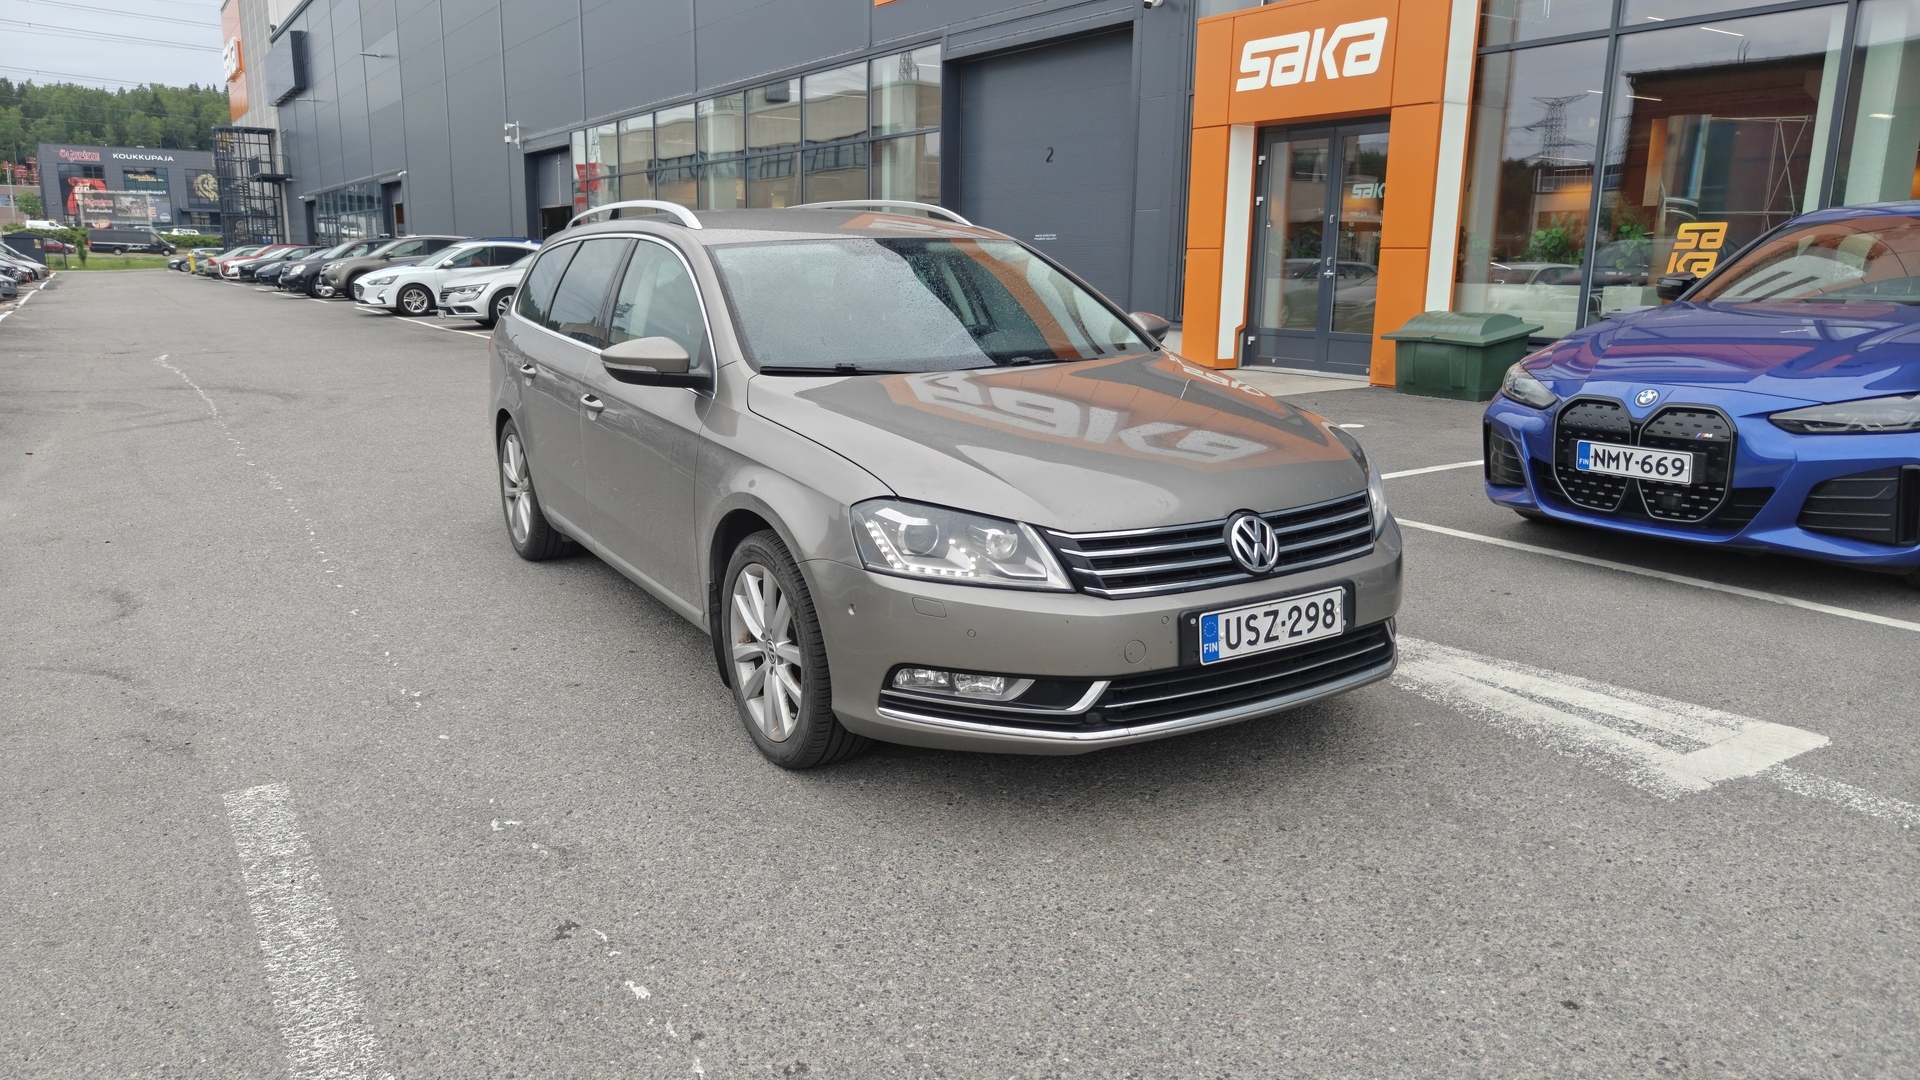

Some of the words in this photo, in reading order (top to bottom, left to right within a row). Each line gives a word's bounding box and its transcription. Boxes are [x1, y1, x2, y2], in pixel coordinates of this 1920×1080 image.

[112, 153, 174, 162] KOUKKUPAJA
[1046, 146, 1054, 163] 2
[1351, 183, 1385, 199] sak
[1593, 448, 1685, 477] NMY-669
[1232, 515, 1278, 572] VW
[1225, 598, 1336, 650] USZ-298
[1203, 641, 1218, 654] FIN
